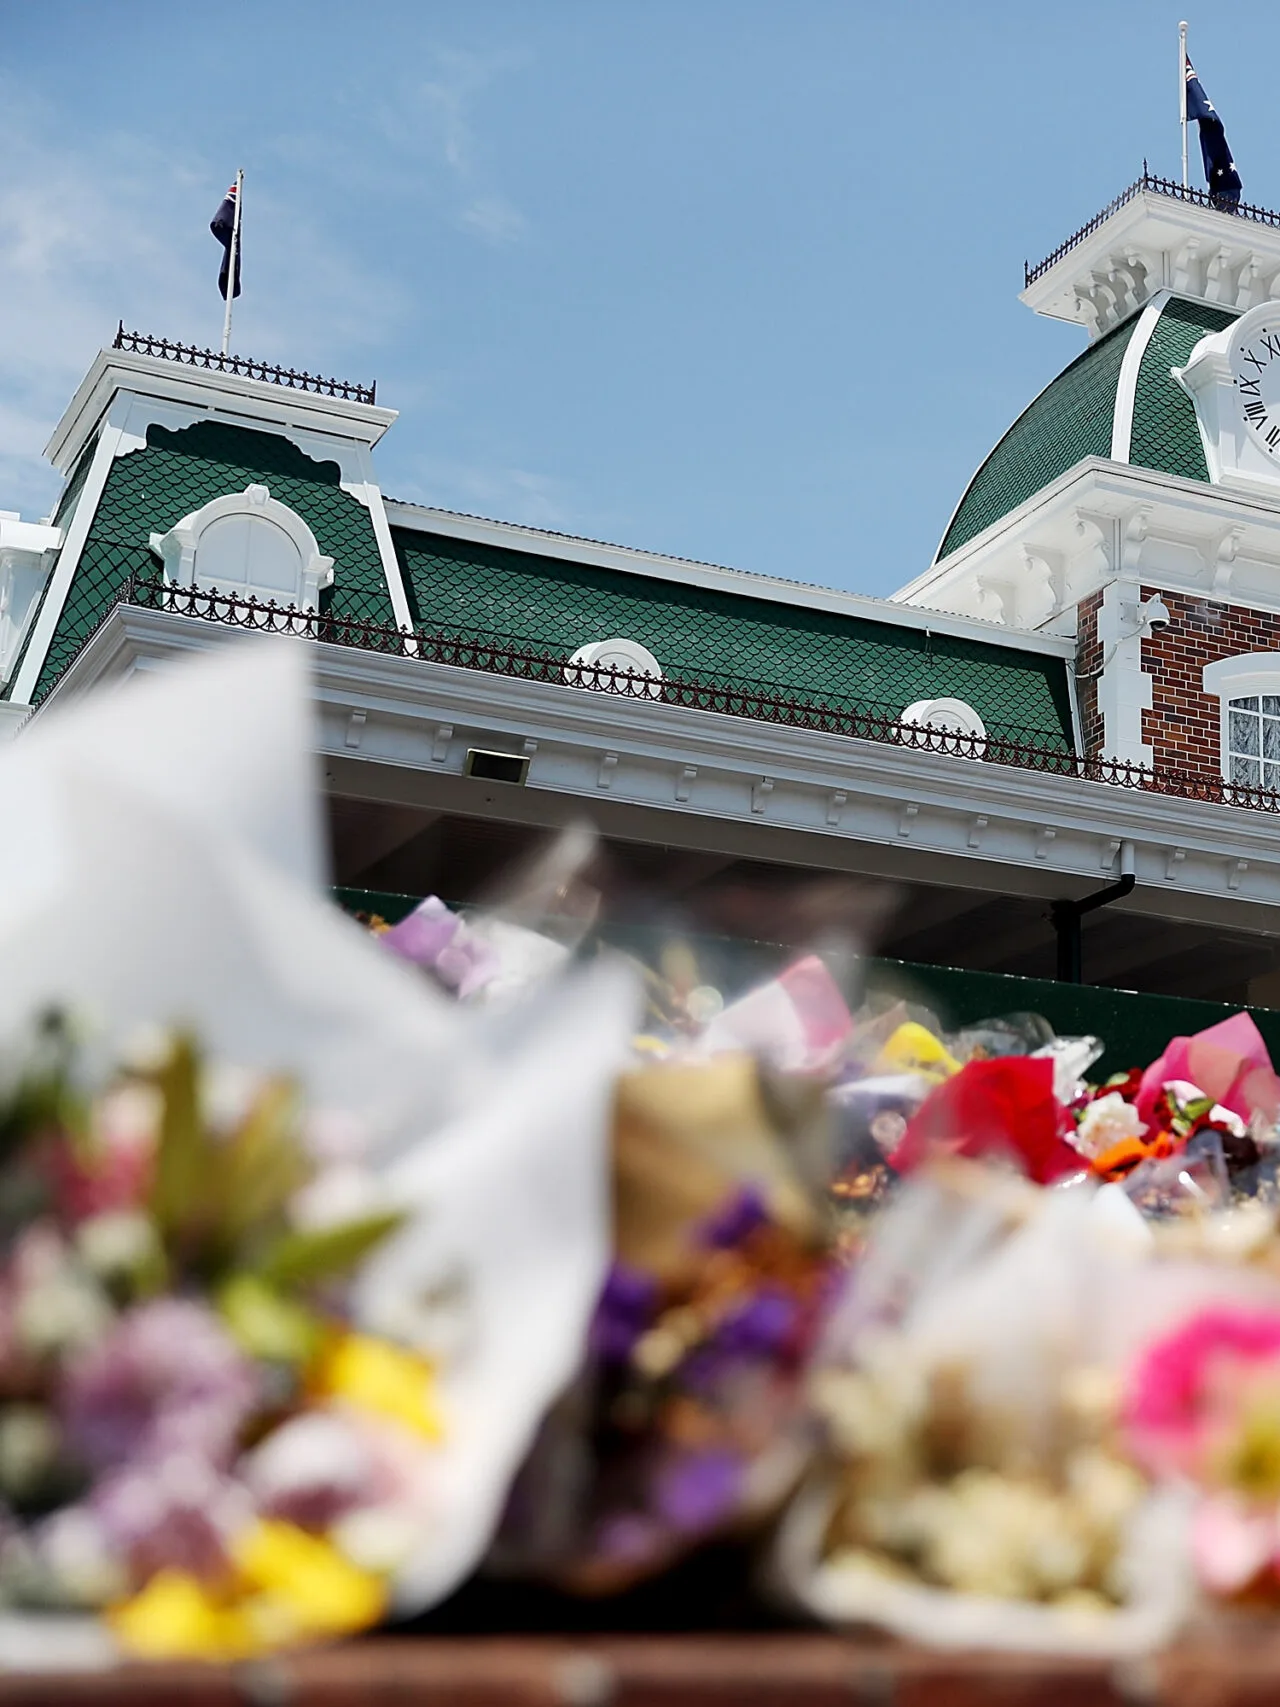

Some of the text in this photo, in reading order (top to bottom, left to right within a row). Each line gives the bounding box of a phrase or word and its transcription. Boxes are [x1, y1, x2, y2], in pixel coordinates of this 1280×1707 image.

[1243, 349, 1267, 374] X
[1239, 374, 1261, 396] IX
[1243, 401, 1268, 431] VIII
